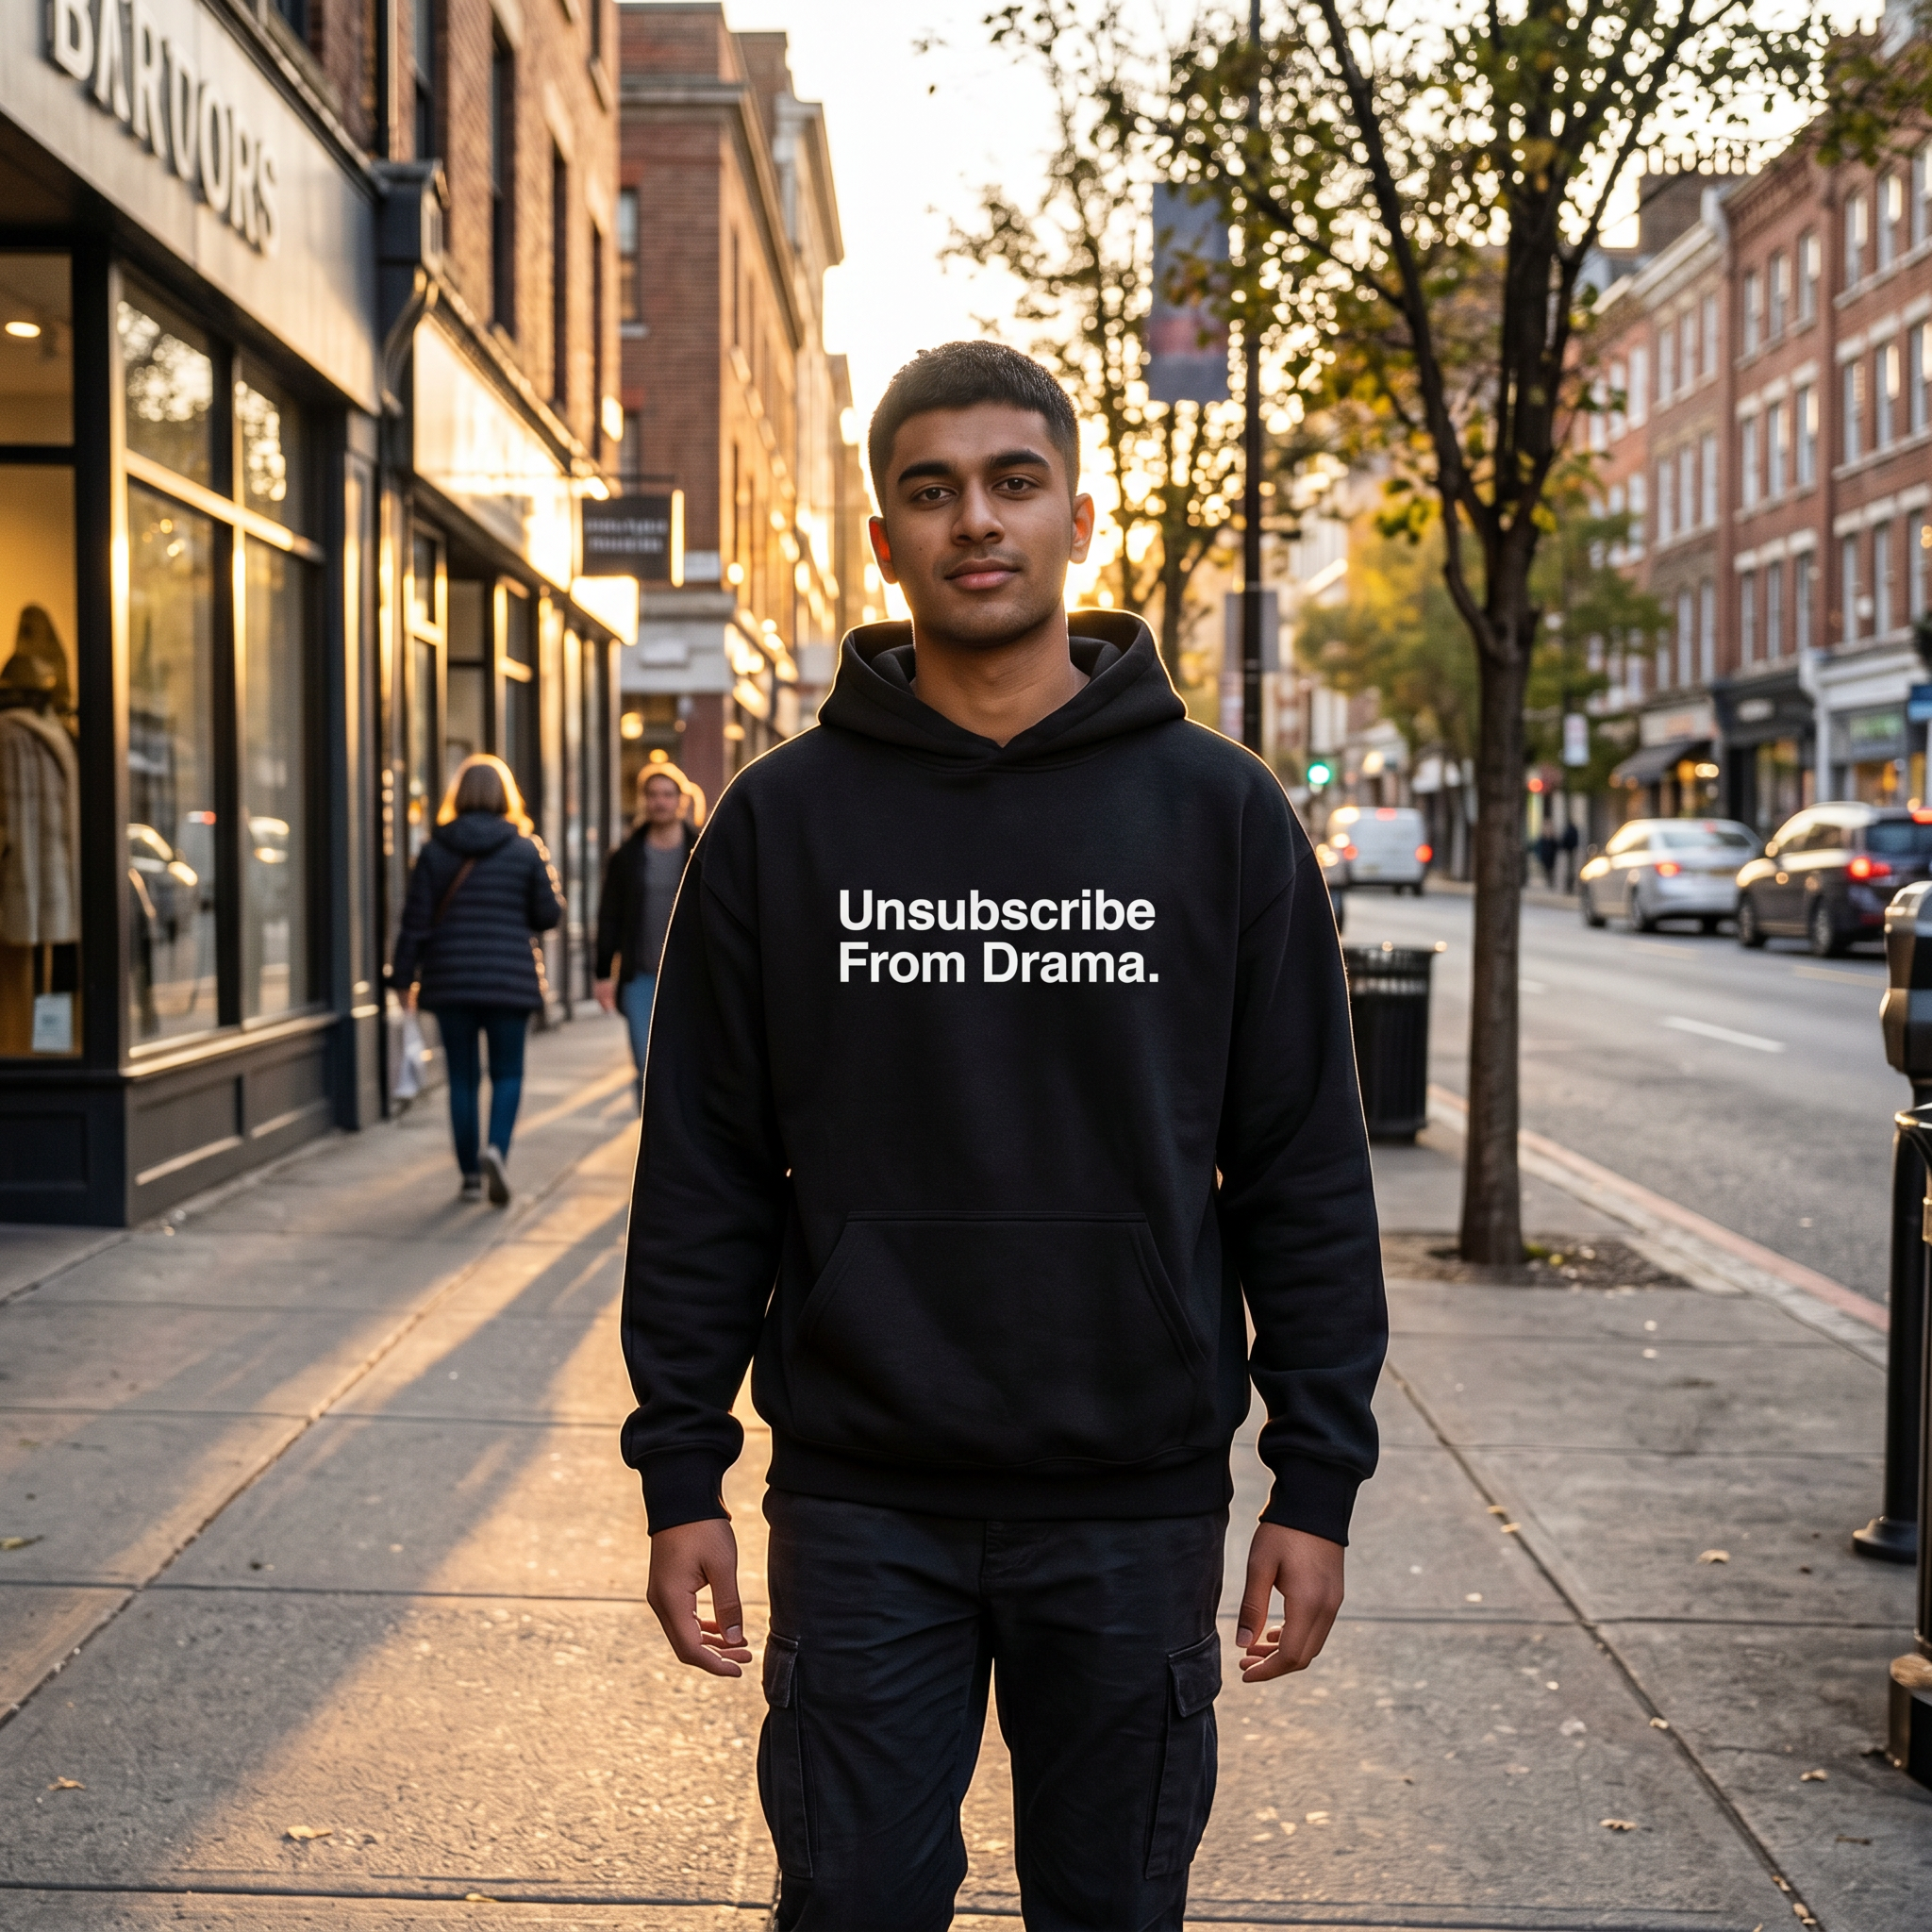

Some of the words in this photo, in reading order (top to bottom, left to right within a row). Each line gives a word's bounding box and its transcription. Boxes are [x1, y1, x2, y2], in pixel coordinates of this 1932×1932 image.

[840, 889, 1156, 931] Unsubscribe
[840, 941, 965, 983] From
[983, 941, 1159, 983] Drama.
